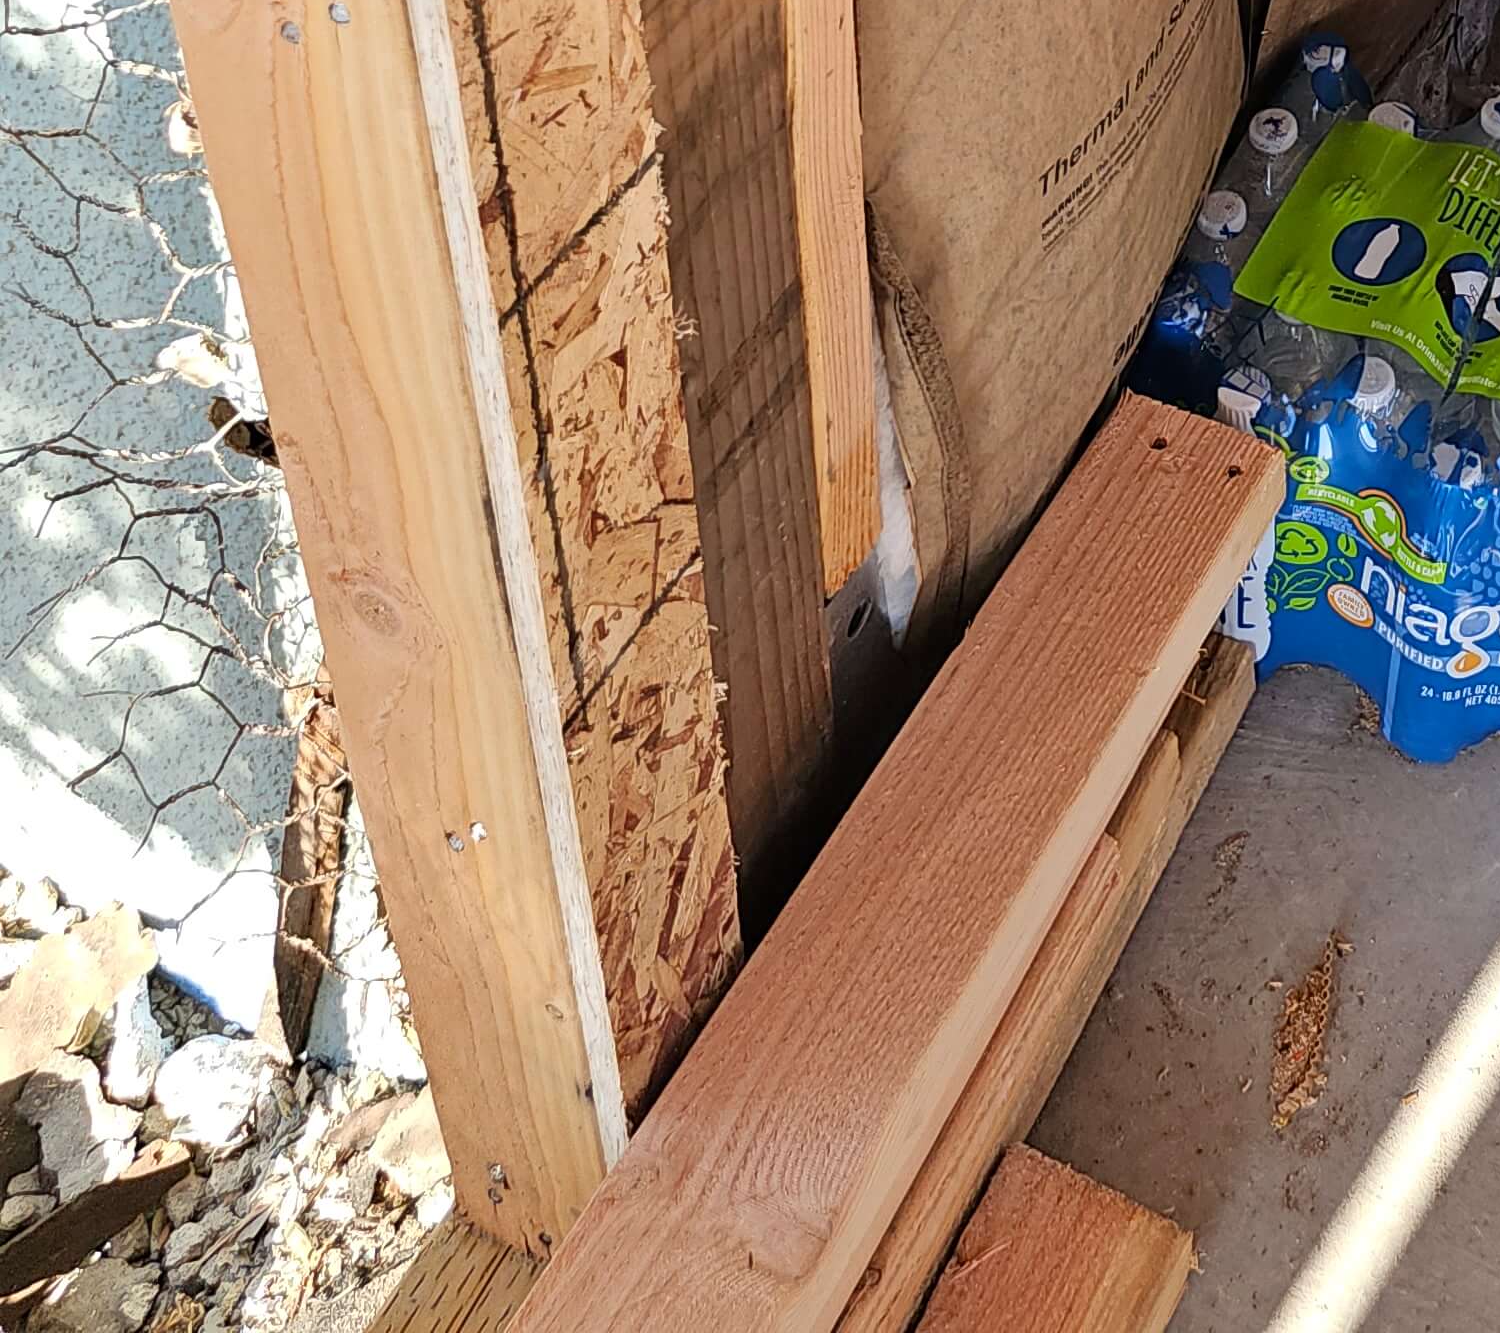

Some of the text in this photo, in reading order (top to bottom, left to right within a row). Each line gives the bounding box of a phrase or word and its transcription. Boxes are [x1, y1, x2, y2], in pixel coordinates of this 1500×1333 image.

[1038, 78, 1132, 198] Thermal
[1376, 619, 1446, 673] PURIFIED
[1420, 685, 1434, 699] 24
